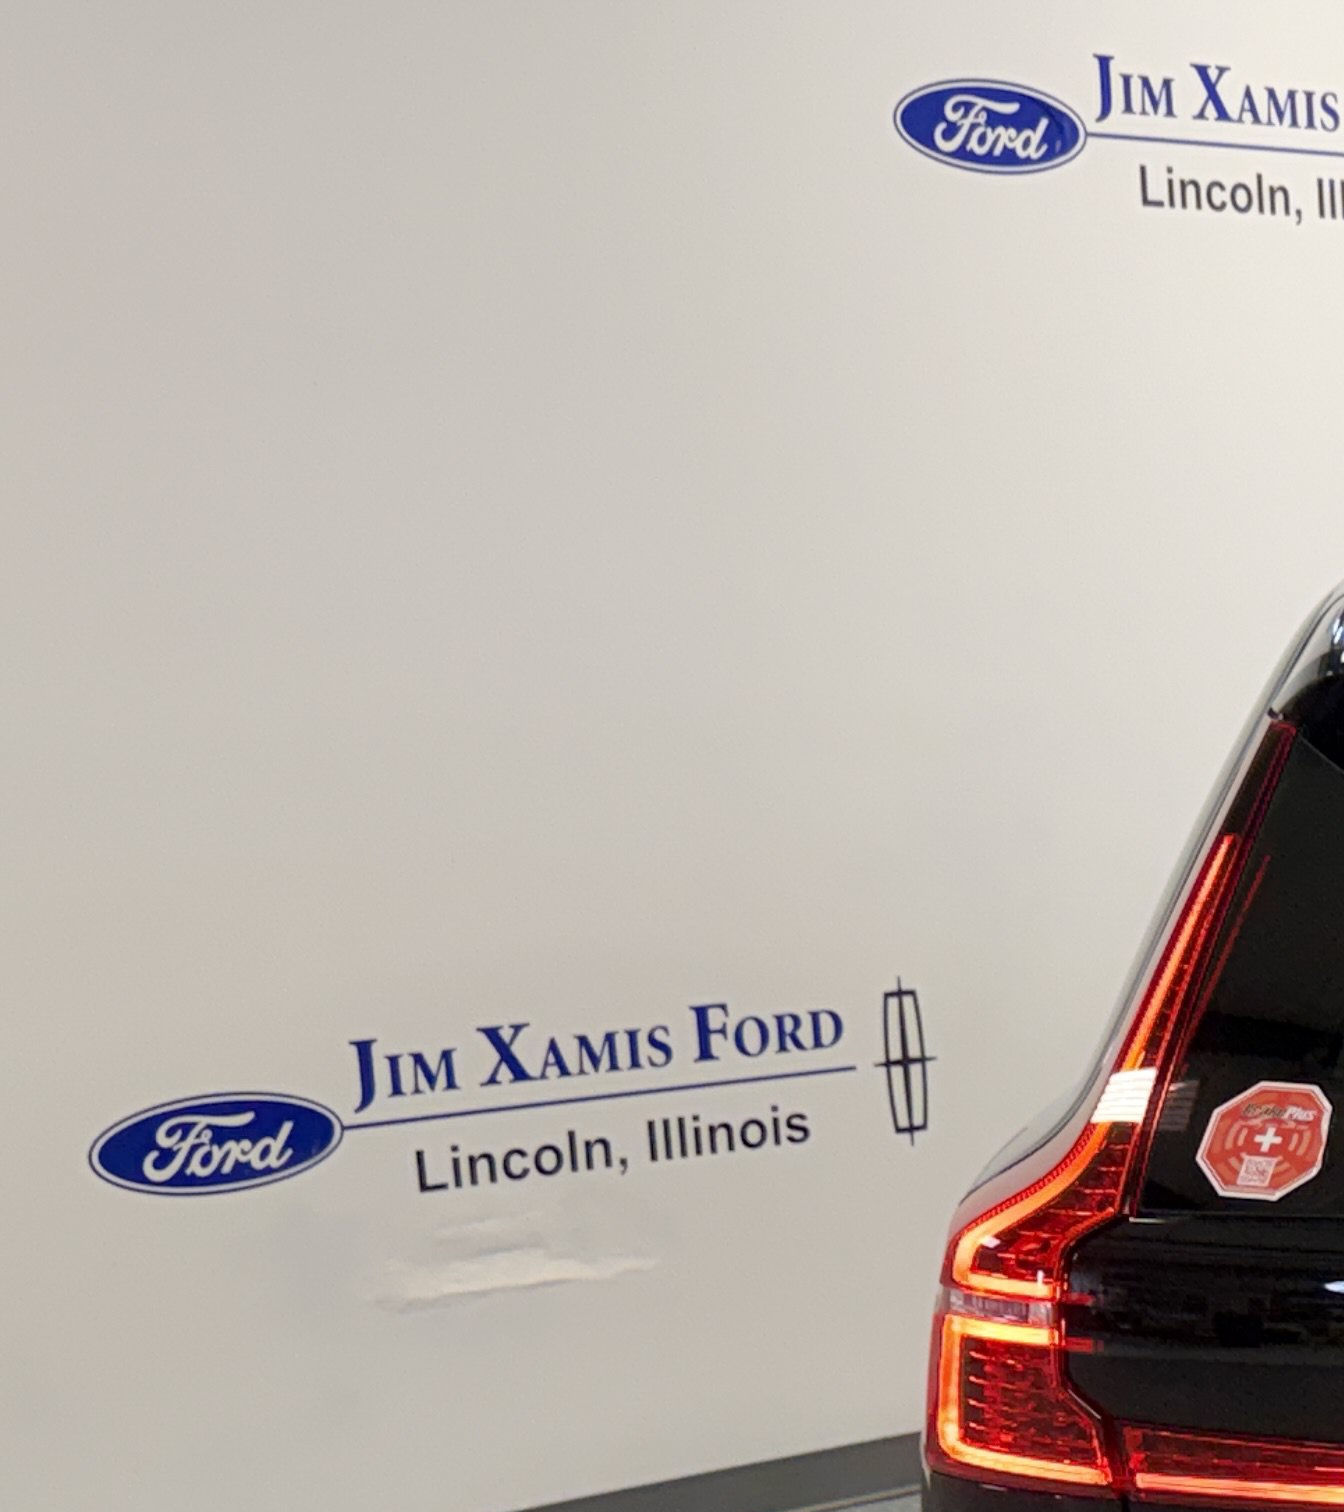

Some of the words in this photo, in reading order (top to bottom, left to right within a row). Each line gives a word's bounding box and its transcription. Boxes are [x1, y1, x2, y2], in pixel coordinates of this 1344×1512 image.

[933, 94, 1048, 162] Ford
[1140, 165, 1303, 226] Lincoln,
[142, 1112, 293, 1185] Ford
[416, 1129, 630, 1193] Lincoln,
[646, 1105, 811, 1164] Illinois
